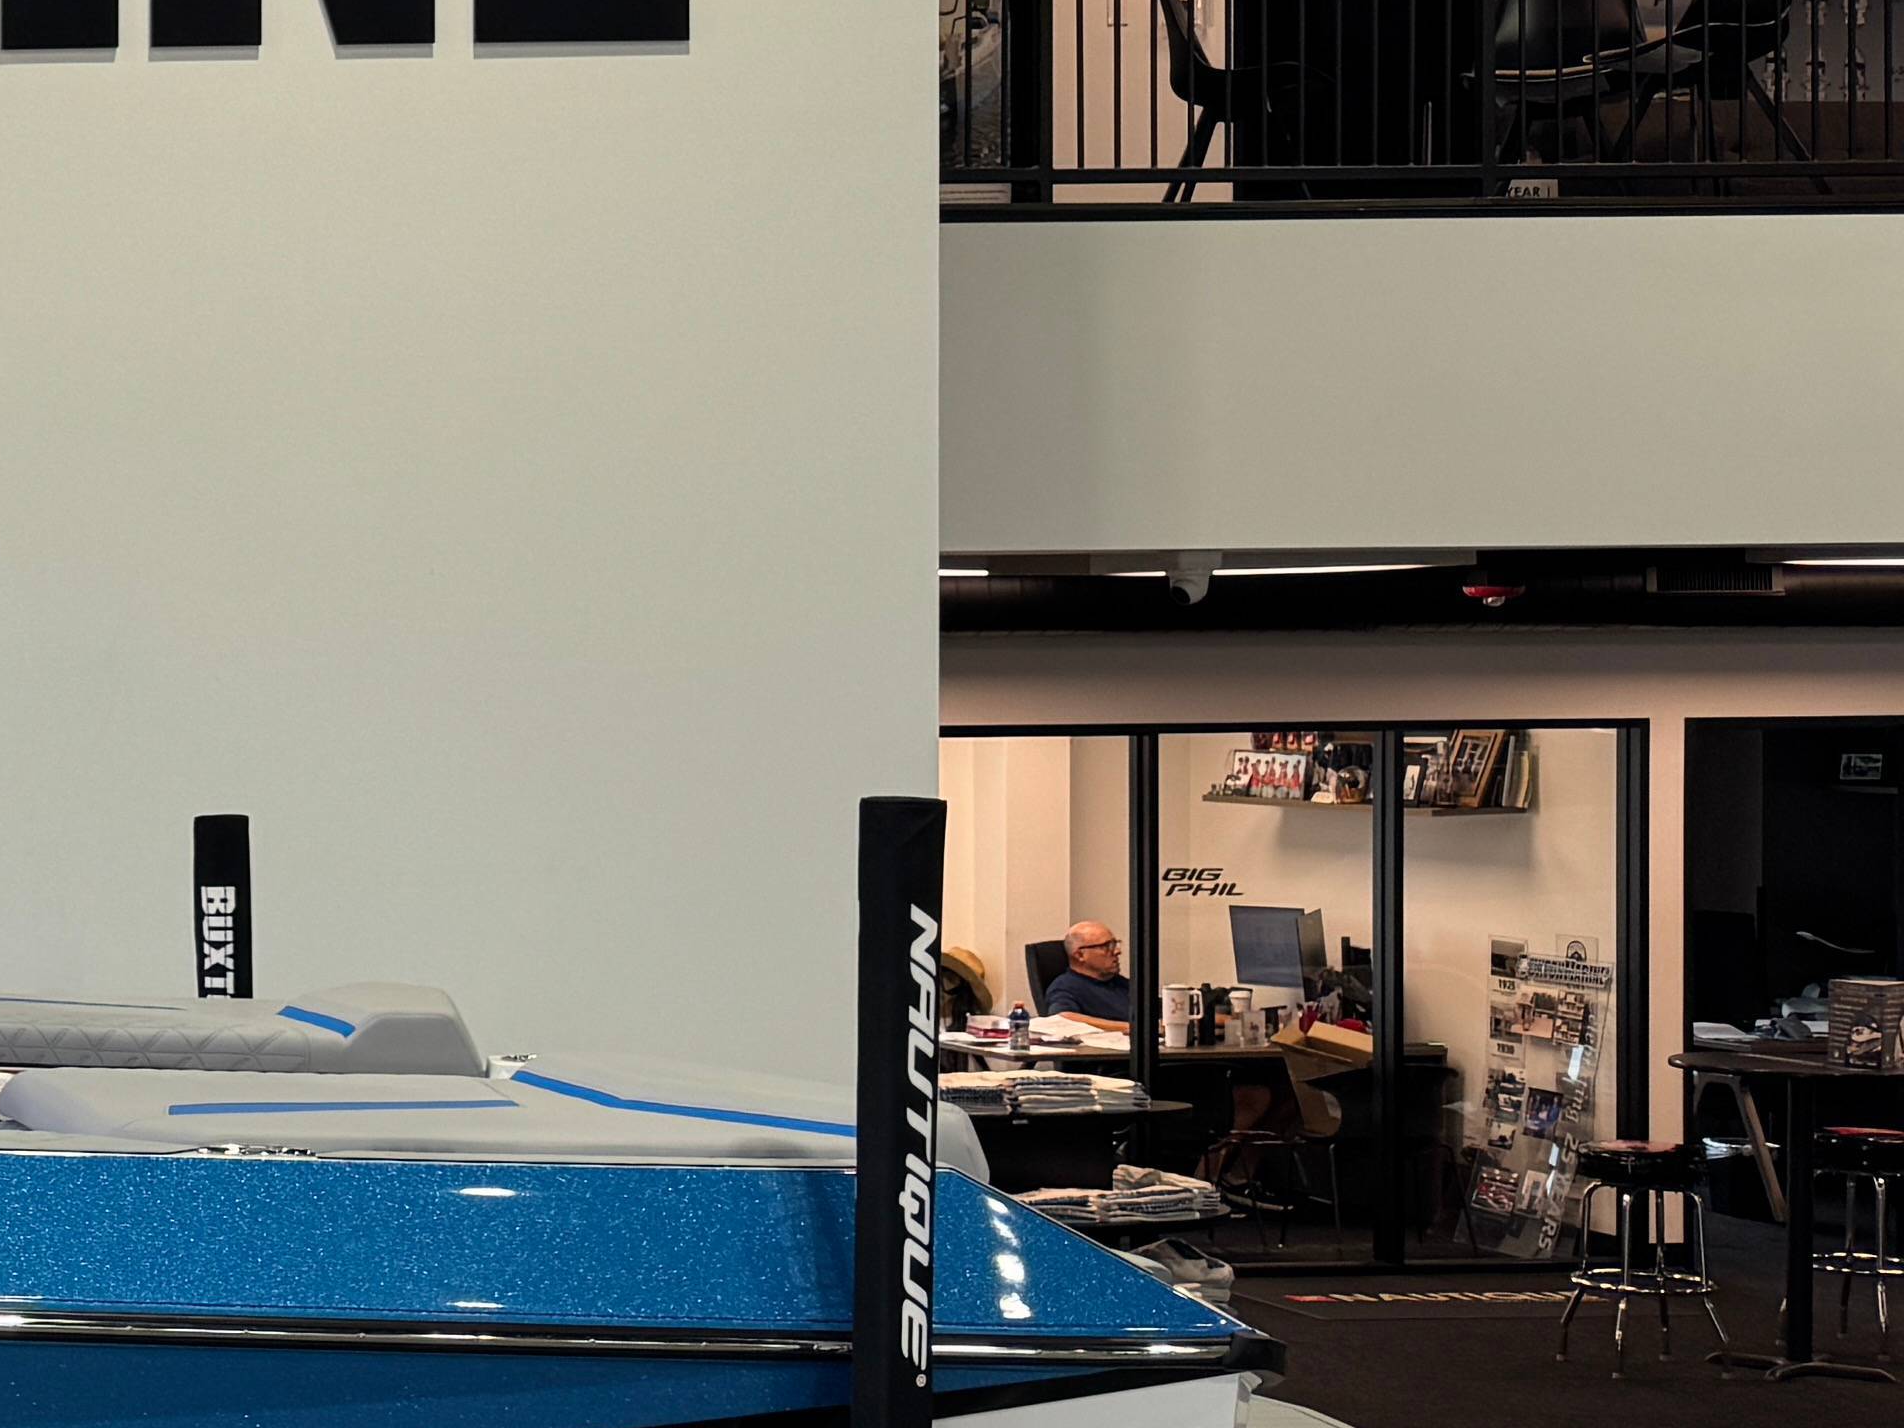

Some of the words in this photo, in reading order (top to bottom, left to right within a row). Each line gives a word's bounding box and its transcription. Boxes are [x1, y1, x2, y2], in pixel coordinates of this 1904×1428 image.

[1162, 867, 1224, 881] BIG
[1165, 882, 1245, 897] PHIL
[200, 885, 236, 999] BUXT
[899, 904, 939, 1372] NAUTIQUE
